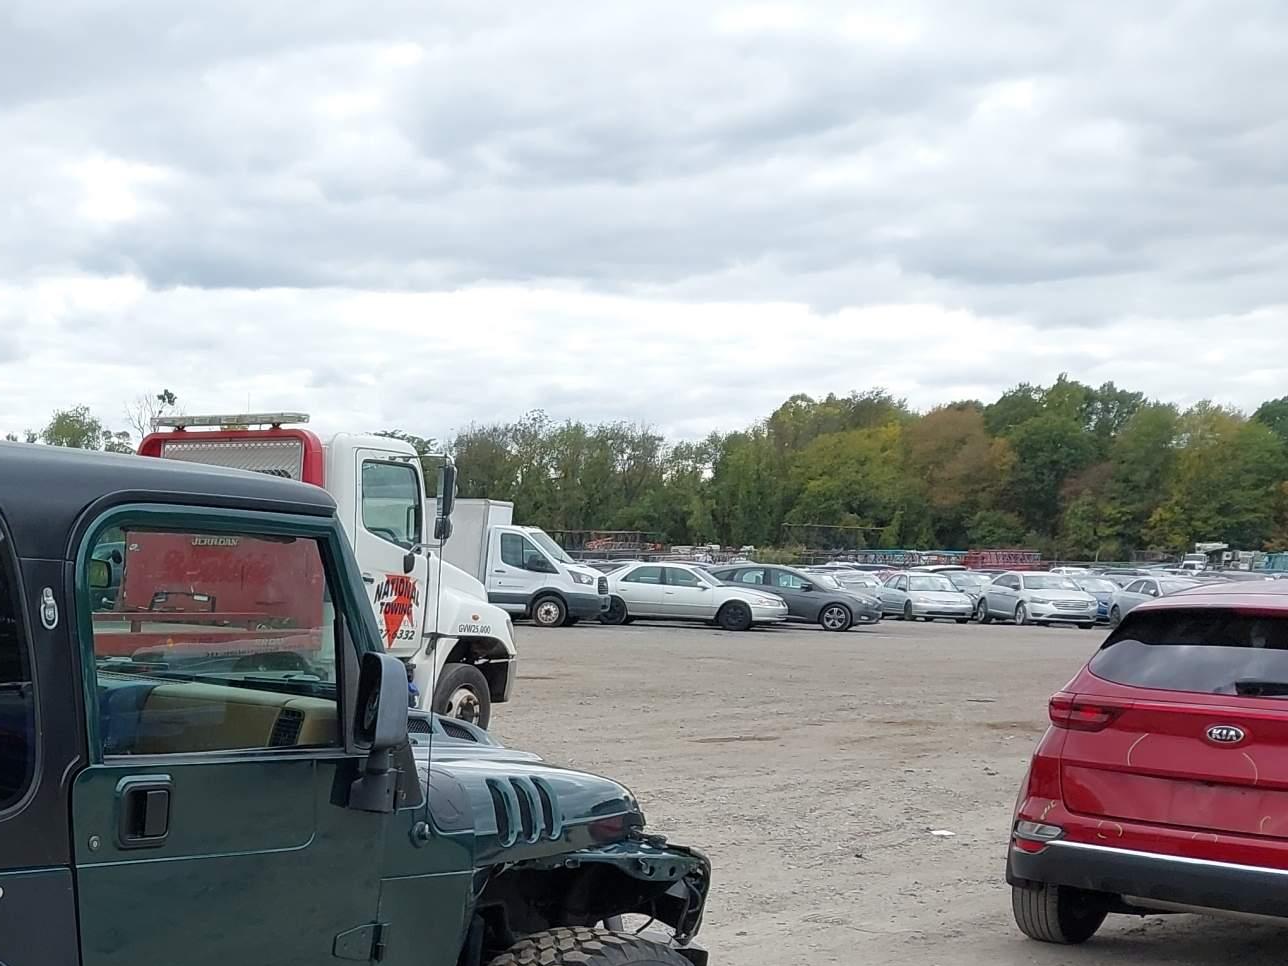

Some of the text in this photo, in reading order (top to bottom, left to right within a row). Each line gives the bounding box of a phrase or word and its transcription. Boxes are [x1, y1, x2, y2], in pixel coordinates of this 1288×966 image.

[374, 578, 420, 608] NATIONAL
[379, 602, 413, 616] TOWING
[1212, 729, 1237, 741] KIA
